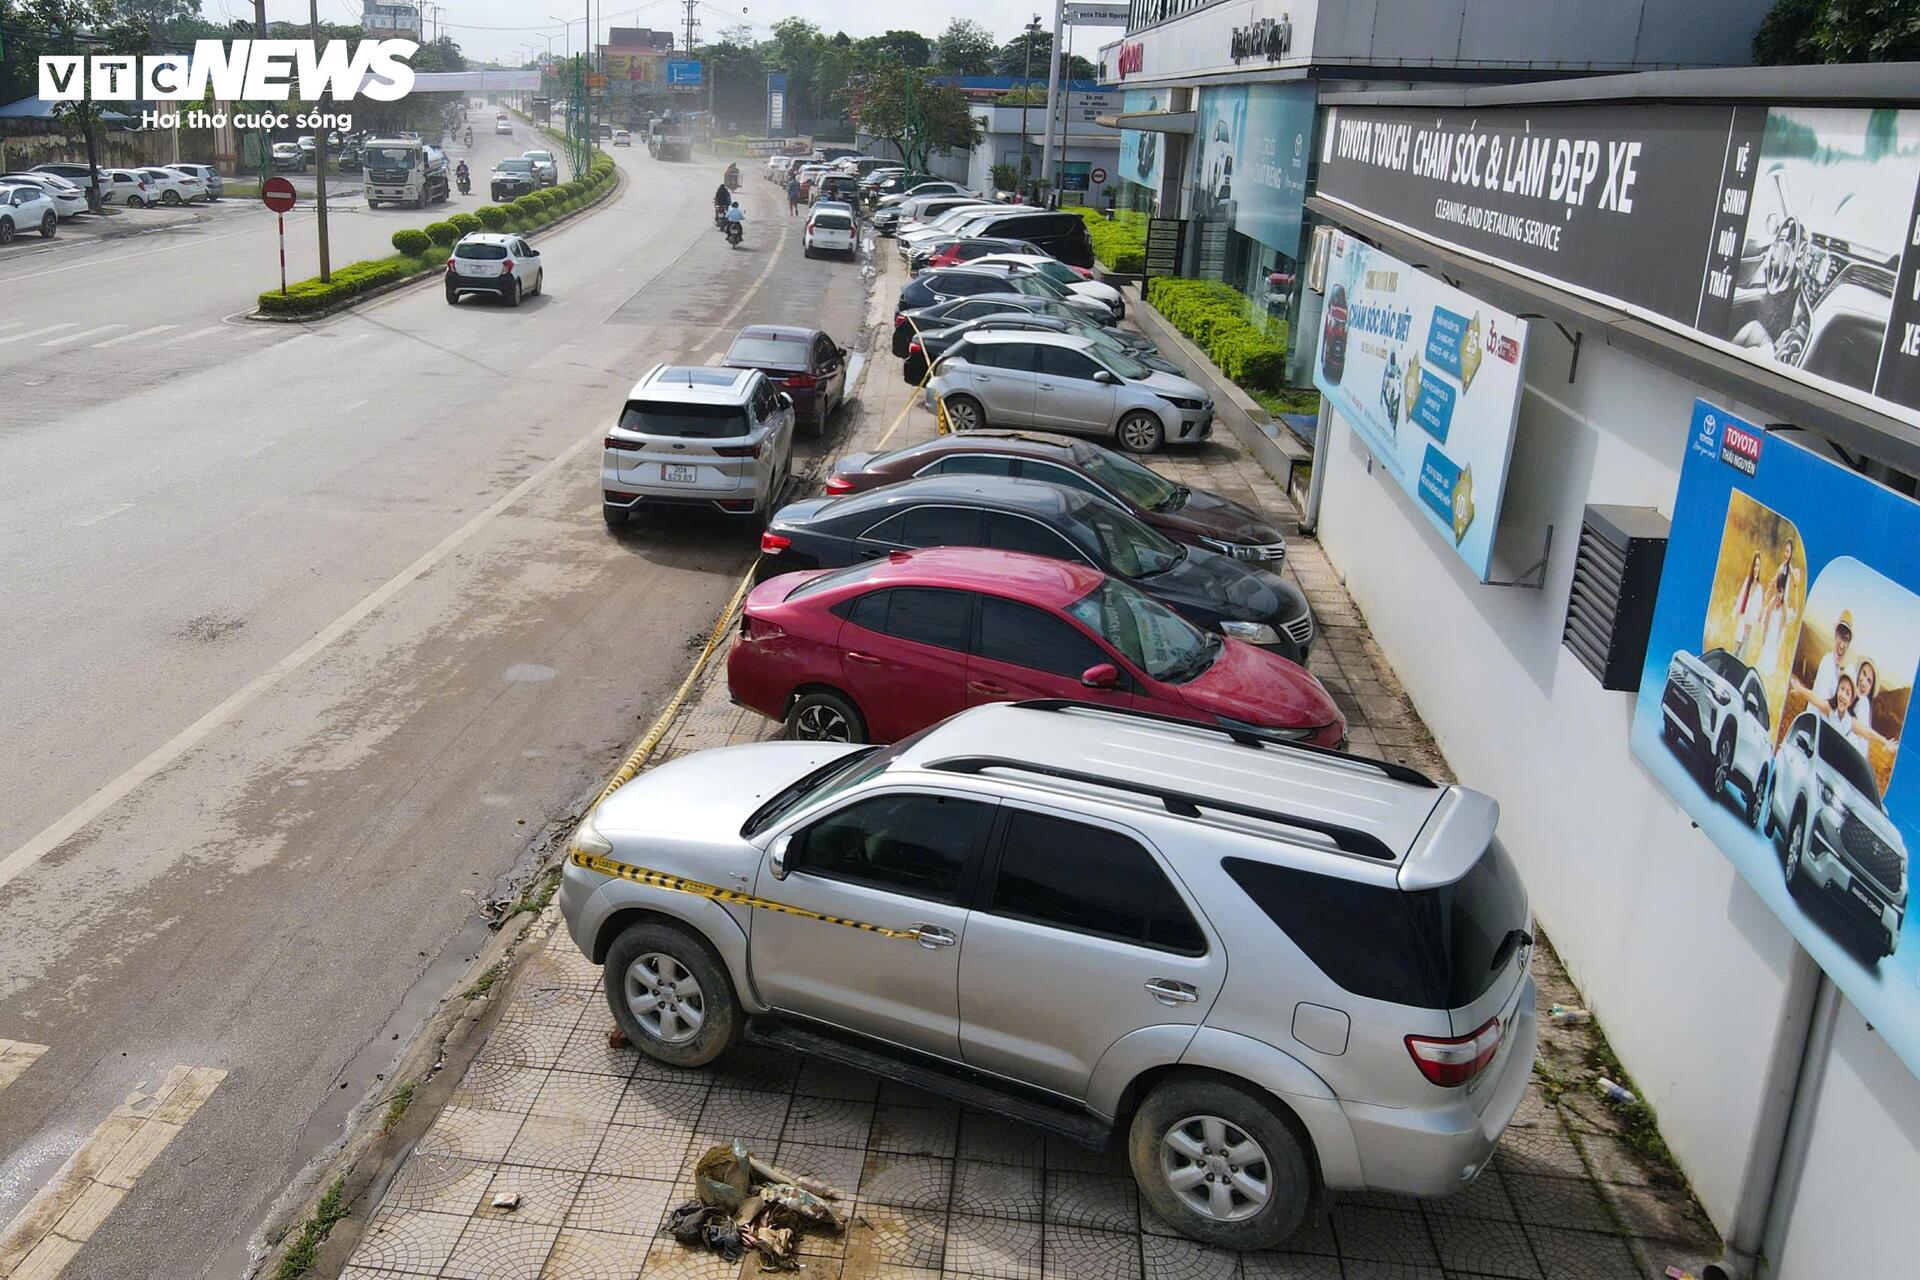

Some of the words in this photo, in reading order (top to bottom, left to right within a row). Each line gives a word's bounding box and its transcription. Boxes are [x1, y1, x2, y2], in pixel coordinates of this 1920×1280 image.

[1338, 119, 1372, 164] TOYOTA
[1372, 122, 1412, 172] TOUCH
[1412, 117, 1454, 182] CHĂM
[1451, 119, 1487, 188] SÓC
[1484, 134, 1503, 191] &
[1502, 119, 1551, 199] LÀM
[1549, 137, 1600, 222] ĐẸP
[1597, 141, 1642, 214] XE
[1735, 141, 1750, 179] VỆ
[1722, 187, 1748, 216] SINH
[1435, 198, 1467, 225] CLEANING
[1465, 205, 1483, 229] AND
[1482, 209, 1525, 242] DETAILING
[1522, 218, 1562, 252] SERVICE
[1717, 225, 1737, 262] NỘI
[1708, 264, 1733, 300] THẤT
[1366, 300, 1381, 334] SÓC
[1395, 305, 1413, 350] BIỆT
[1726, 427, 1758, 457] TOYOTA
[1721, 447, 1735, 464] THÁI
[1733, 455, 1757, 476] NGUYÊN
